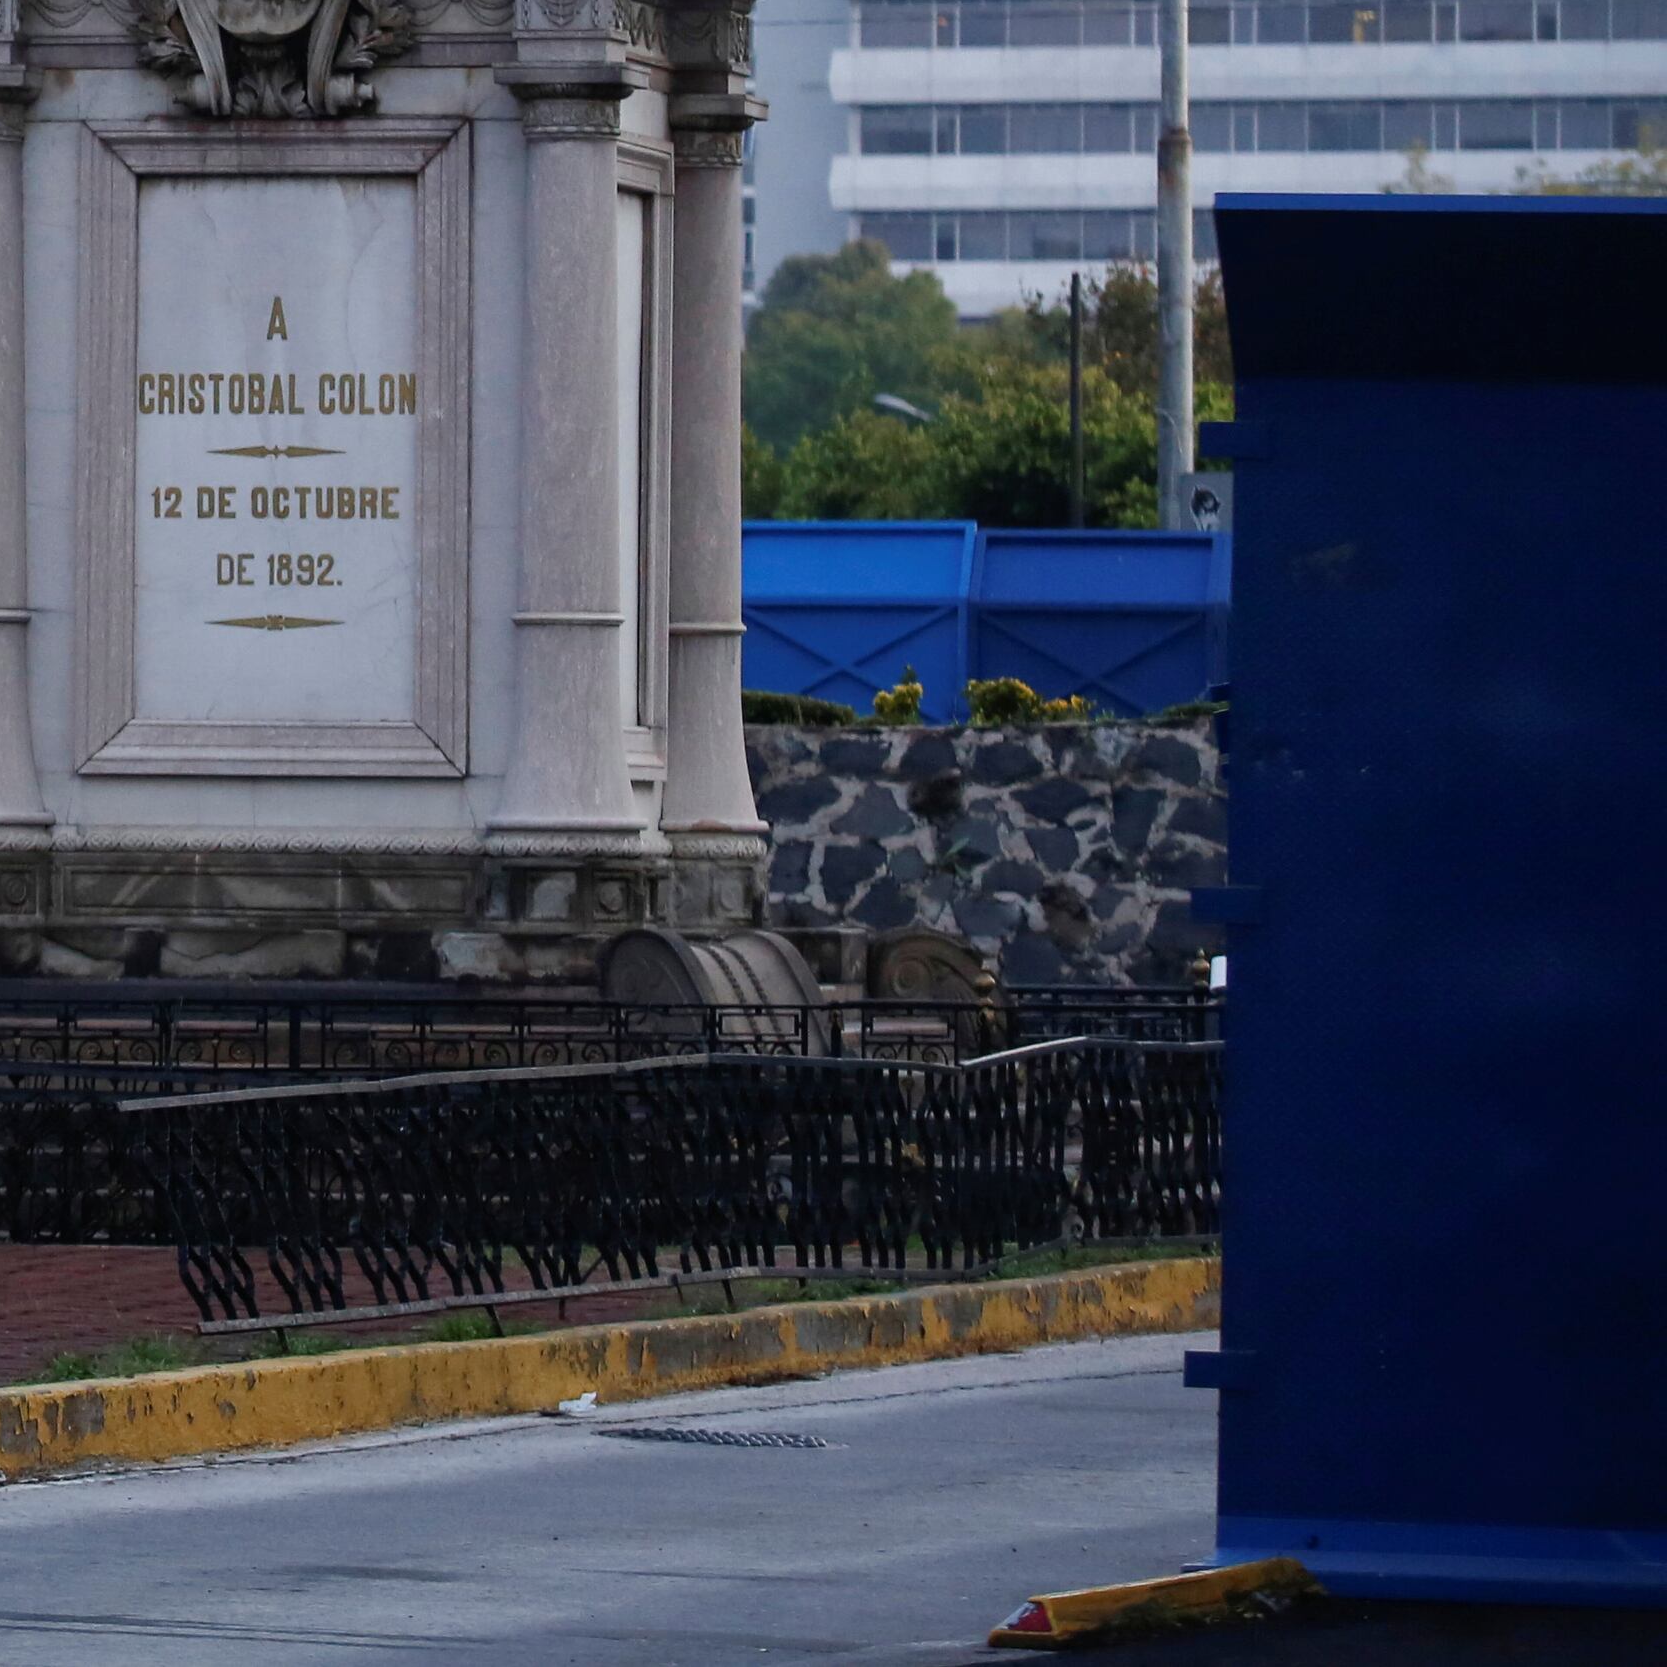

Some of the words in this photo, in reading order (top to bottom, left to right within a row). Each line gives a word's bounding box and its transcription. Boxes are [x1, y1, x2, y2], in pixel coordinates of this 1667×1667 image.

[266, 295, 288, 341] A
[138, 373, 305, 415] CRISTOBAL
[318, 373, 417, 415] COLON
[151, 486, 183, 519] 12
[196, 486, 237, 519] DE
[250, 486, 400, 520] OCTUBRE
[216, 553, 255, 586] DE
[266, 553, 344, 586] 1892.
